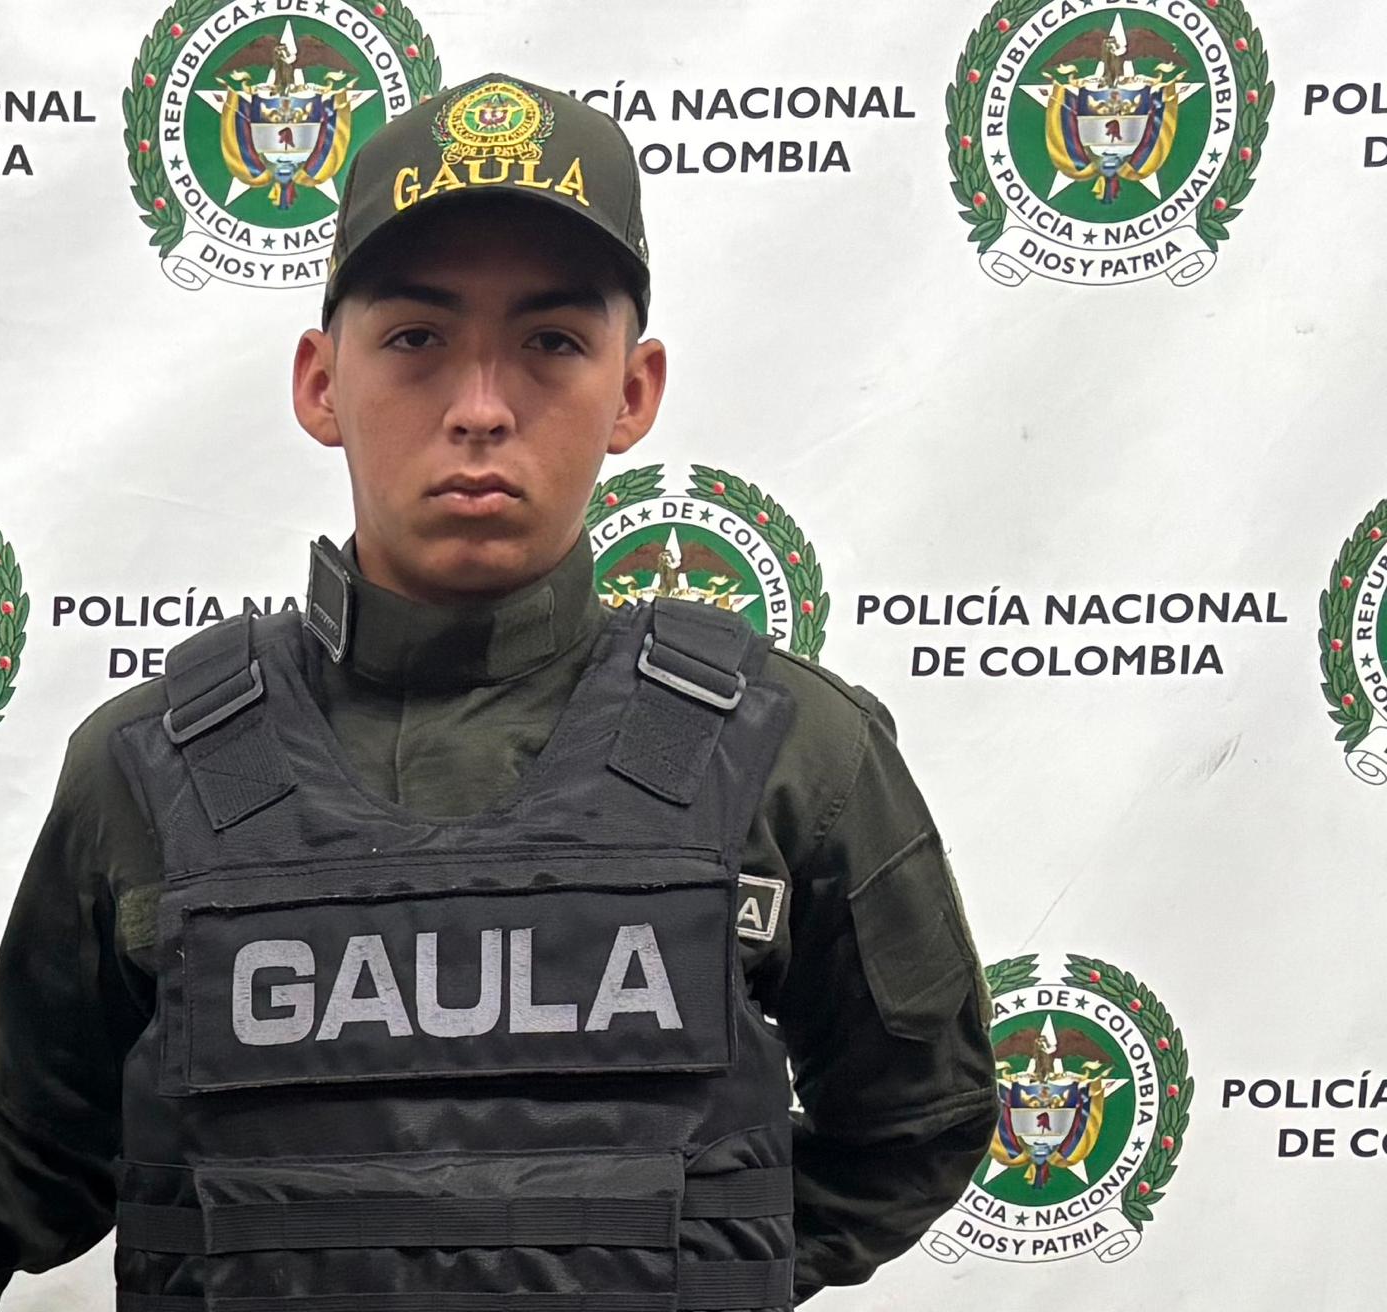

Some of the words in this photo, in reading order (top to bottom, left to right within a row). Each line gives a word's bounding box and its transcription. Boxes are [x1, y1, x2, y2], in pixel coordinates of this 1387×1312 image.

[1165, 0, 1233, 135] COLOMBIA
[672, 86, 915, 120] NACIONAL
[639, 141, 850, 174] OLOMBIA
[393, 156, 590, 212] GAULA
[1103, 167, 1217, 246] NACIONAL
[1100, 241, 1184, 277] PATRIA
[53, 587, 224, 626] POLICÍA
[857, 586, 1029, 625] POLICÍA
[1045, 592, 1287, 625] NACIONAL
[109, 648, 164, 678] DE
[912, 647, 965, 676] DE
[980, 645, 1223, 676] COLOMBIA
[232, 923, 684, 1047] GAULA
[1038, 990, 1069, 1007] DE
[1093, 1004, 1155, 1126] COLOMBIA
[1278, 1129, 1335, 1157] DE
[1035, 1155, 1141, 1226] NACIONAL
